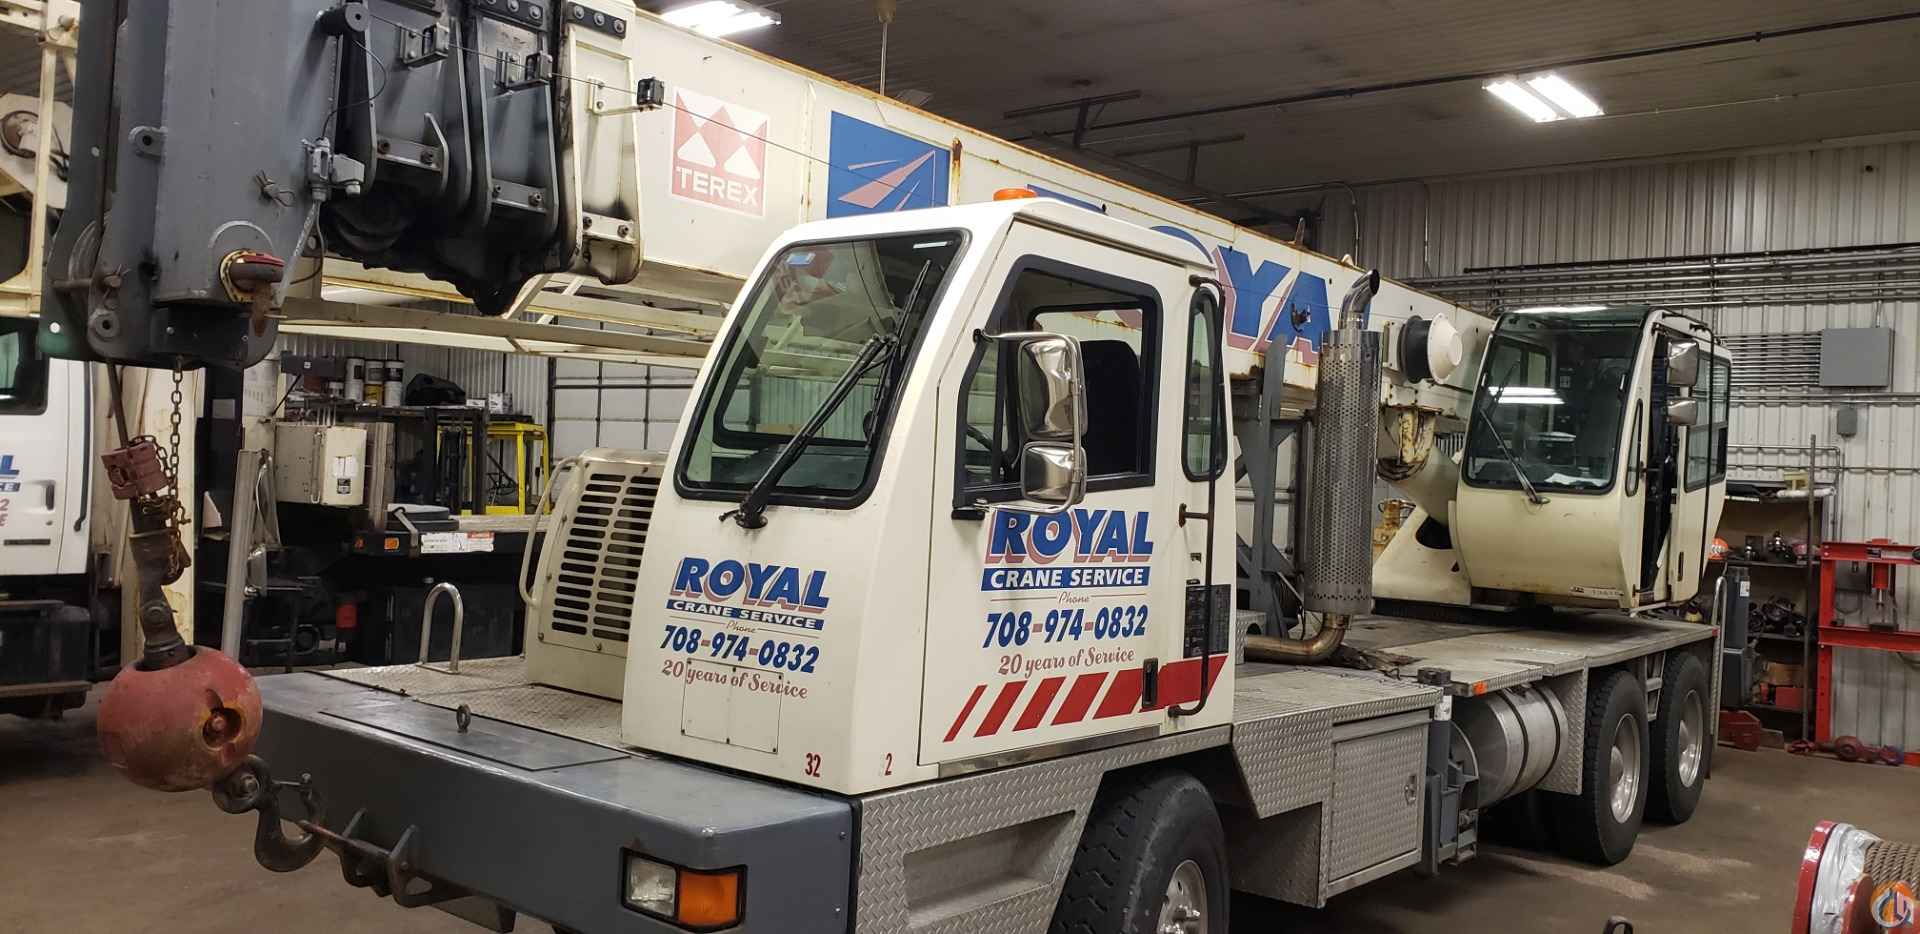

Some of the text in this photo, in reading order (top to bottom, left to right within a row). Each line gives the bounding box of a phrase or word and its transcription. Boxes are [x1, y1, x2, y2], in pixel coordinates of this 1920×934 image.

[675, 166, 759, 207] TEREX
[985, 508, 1154, 564] ROYAL
[670, 557, 830, 613] ROYAL
[990, 568, 1144, 588] CRANE SERVICE
[1058, 591, 1090, 604] Phone
[673, 600, 817, 629] CRANE SERVICE
[725, 620, 758, 634] Phone
[982, 604, 1149, 649] 708-974-0832
[660, 625, 820, 673] 708-974-0832
[998, 646, 1135, 678] 20 years of Service
[661, 659, 808, 699] 20 years of Service
[804, 752, 821, 778] 32
[884, 752, 893, 776] 2
